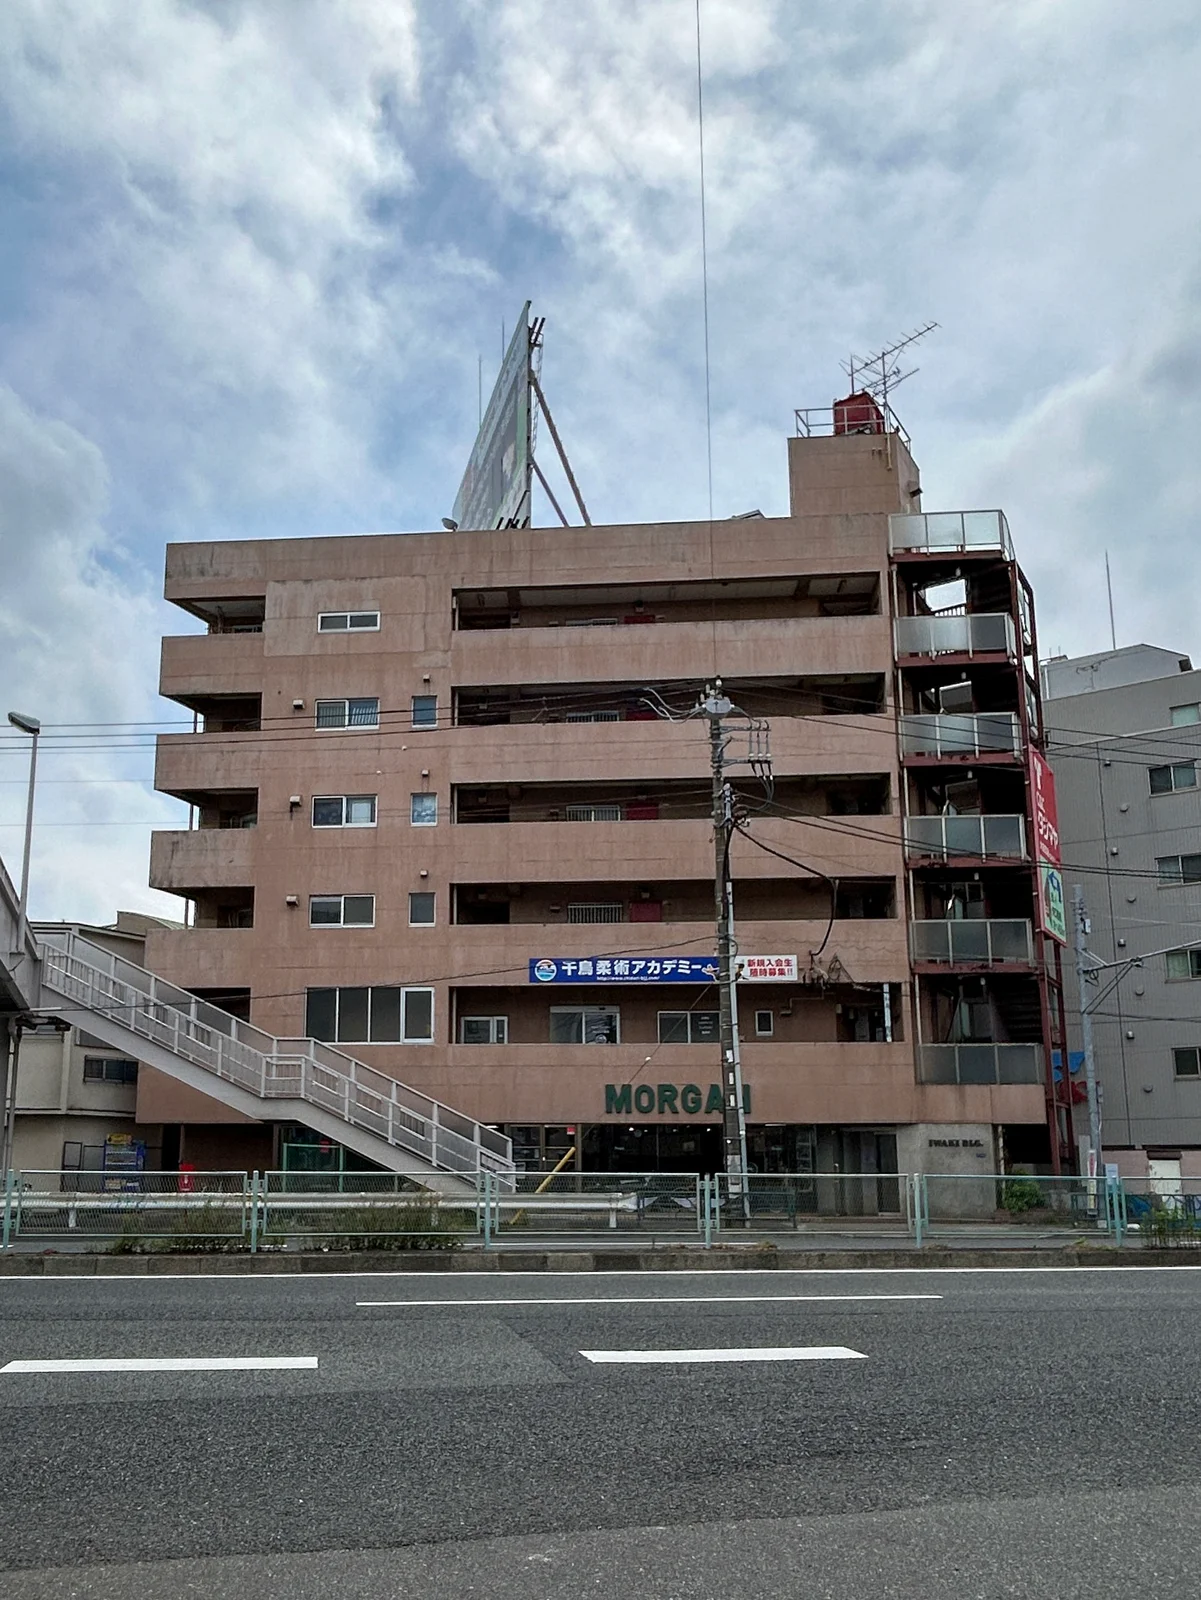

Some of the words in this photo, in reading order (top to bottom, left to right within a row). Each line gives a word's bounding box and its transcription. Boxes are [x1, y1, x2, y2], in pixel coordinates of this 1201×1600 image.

[561, 959, 703, 976] 千鳥柔術アカデミー
[747, 958, 792, 967] 新規入会生
